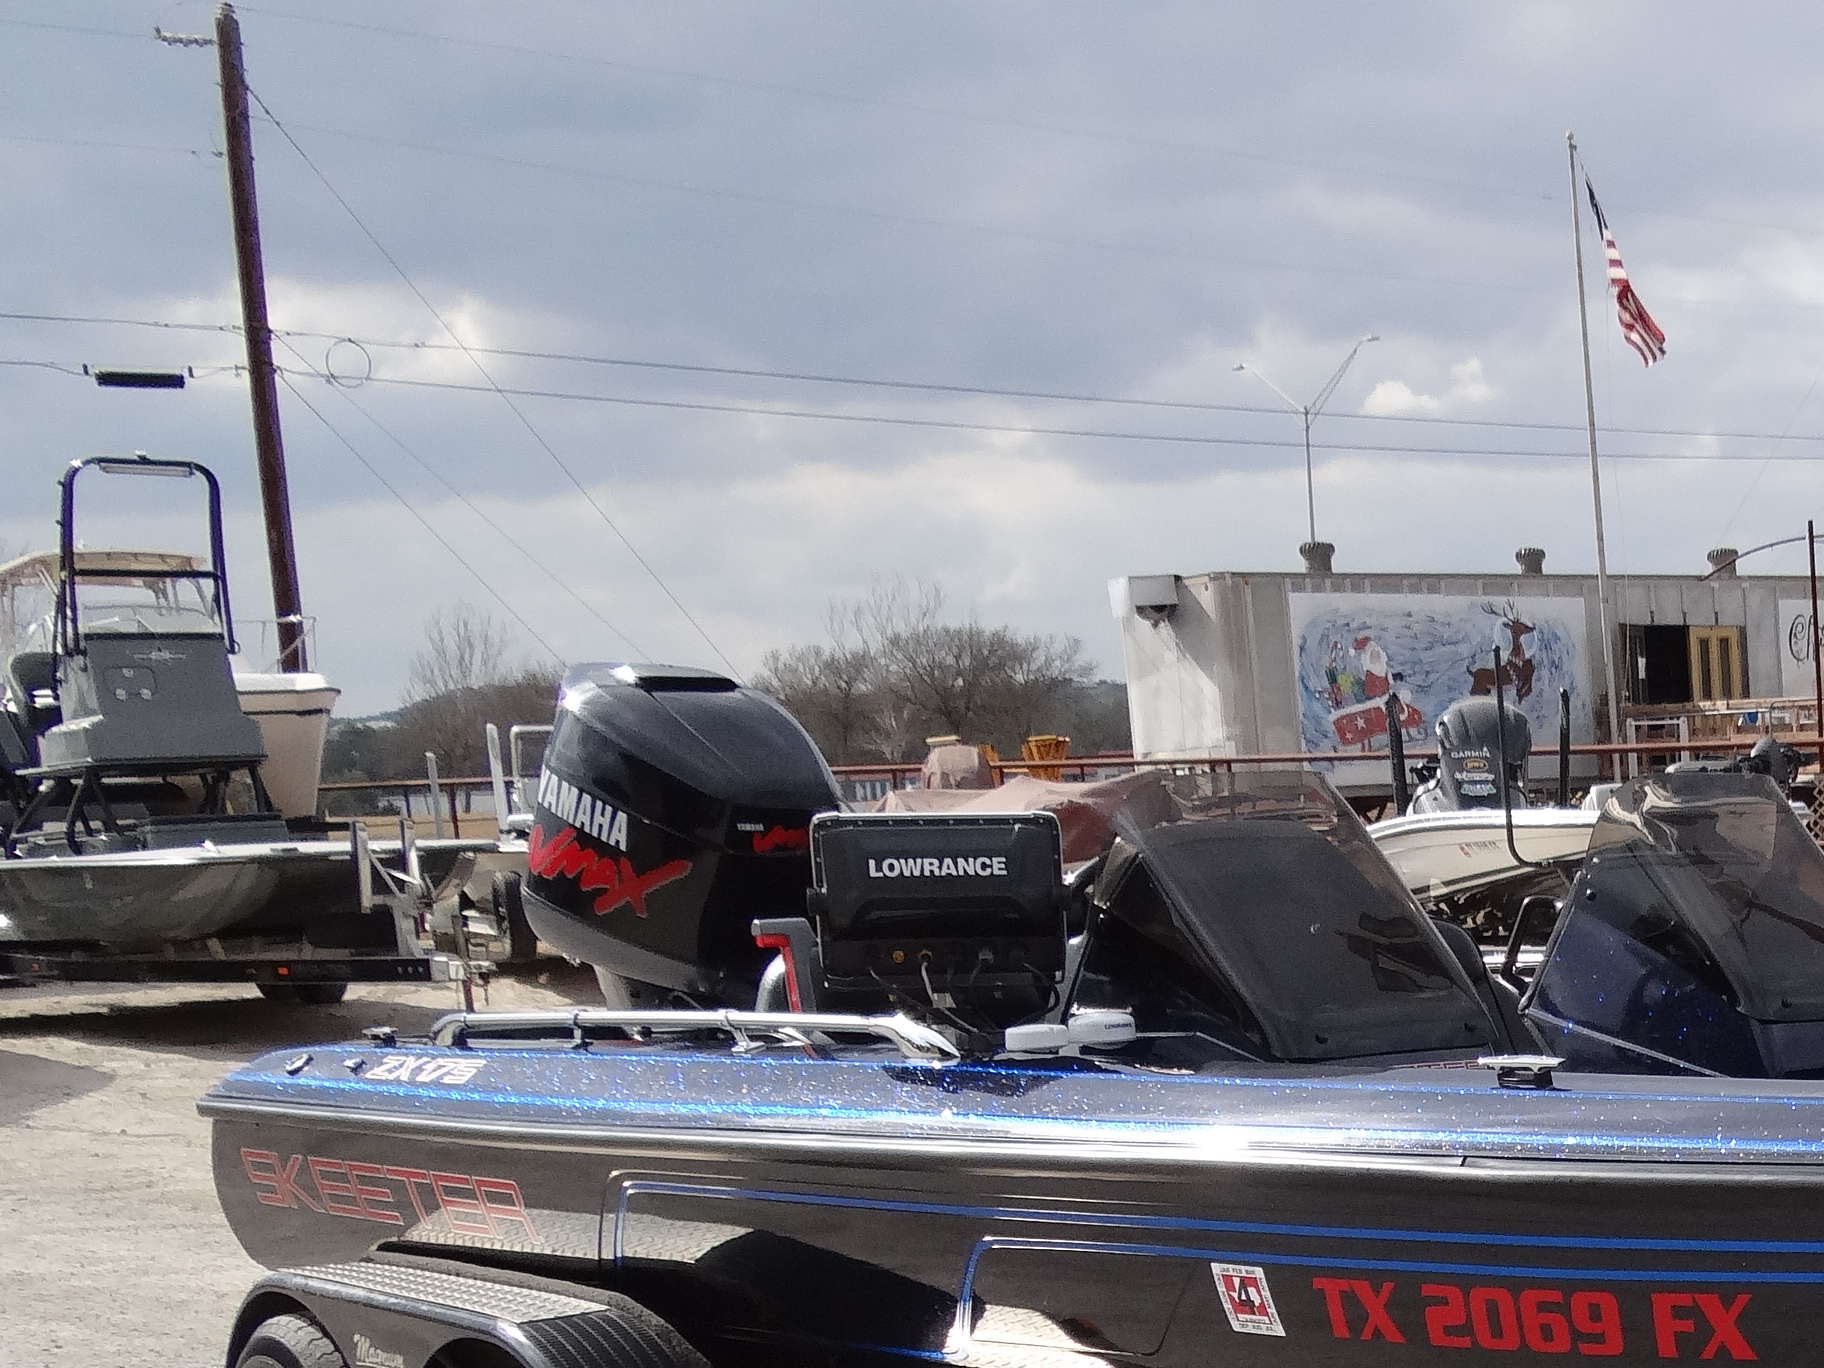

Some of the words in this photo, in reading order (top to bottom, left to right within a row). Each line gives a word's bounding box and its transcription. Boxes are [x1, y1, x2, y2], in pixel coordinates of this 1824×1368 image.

[1451, 750, 1490, 759] GARMIN
[538, 769, 628, 852] YAMAHA
[868, 857, 1008, 878] LOWRANCE
[240, 1147, 546, 1246] SKEETER
[1312, 1277, 1407, 1344] TX
[1420, 1283, 1625, 1357] 2069
[1650, 1293, 1759, 1361] FX
